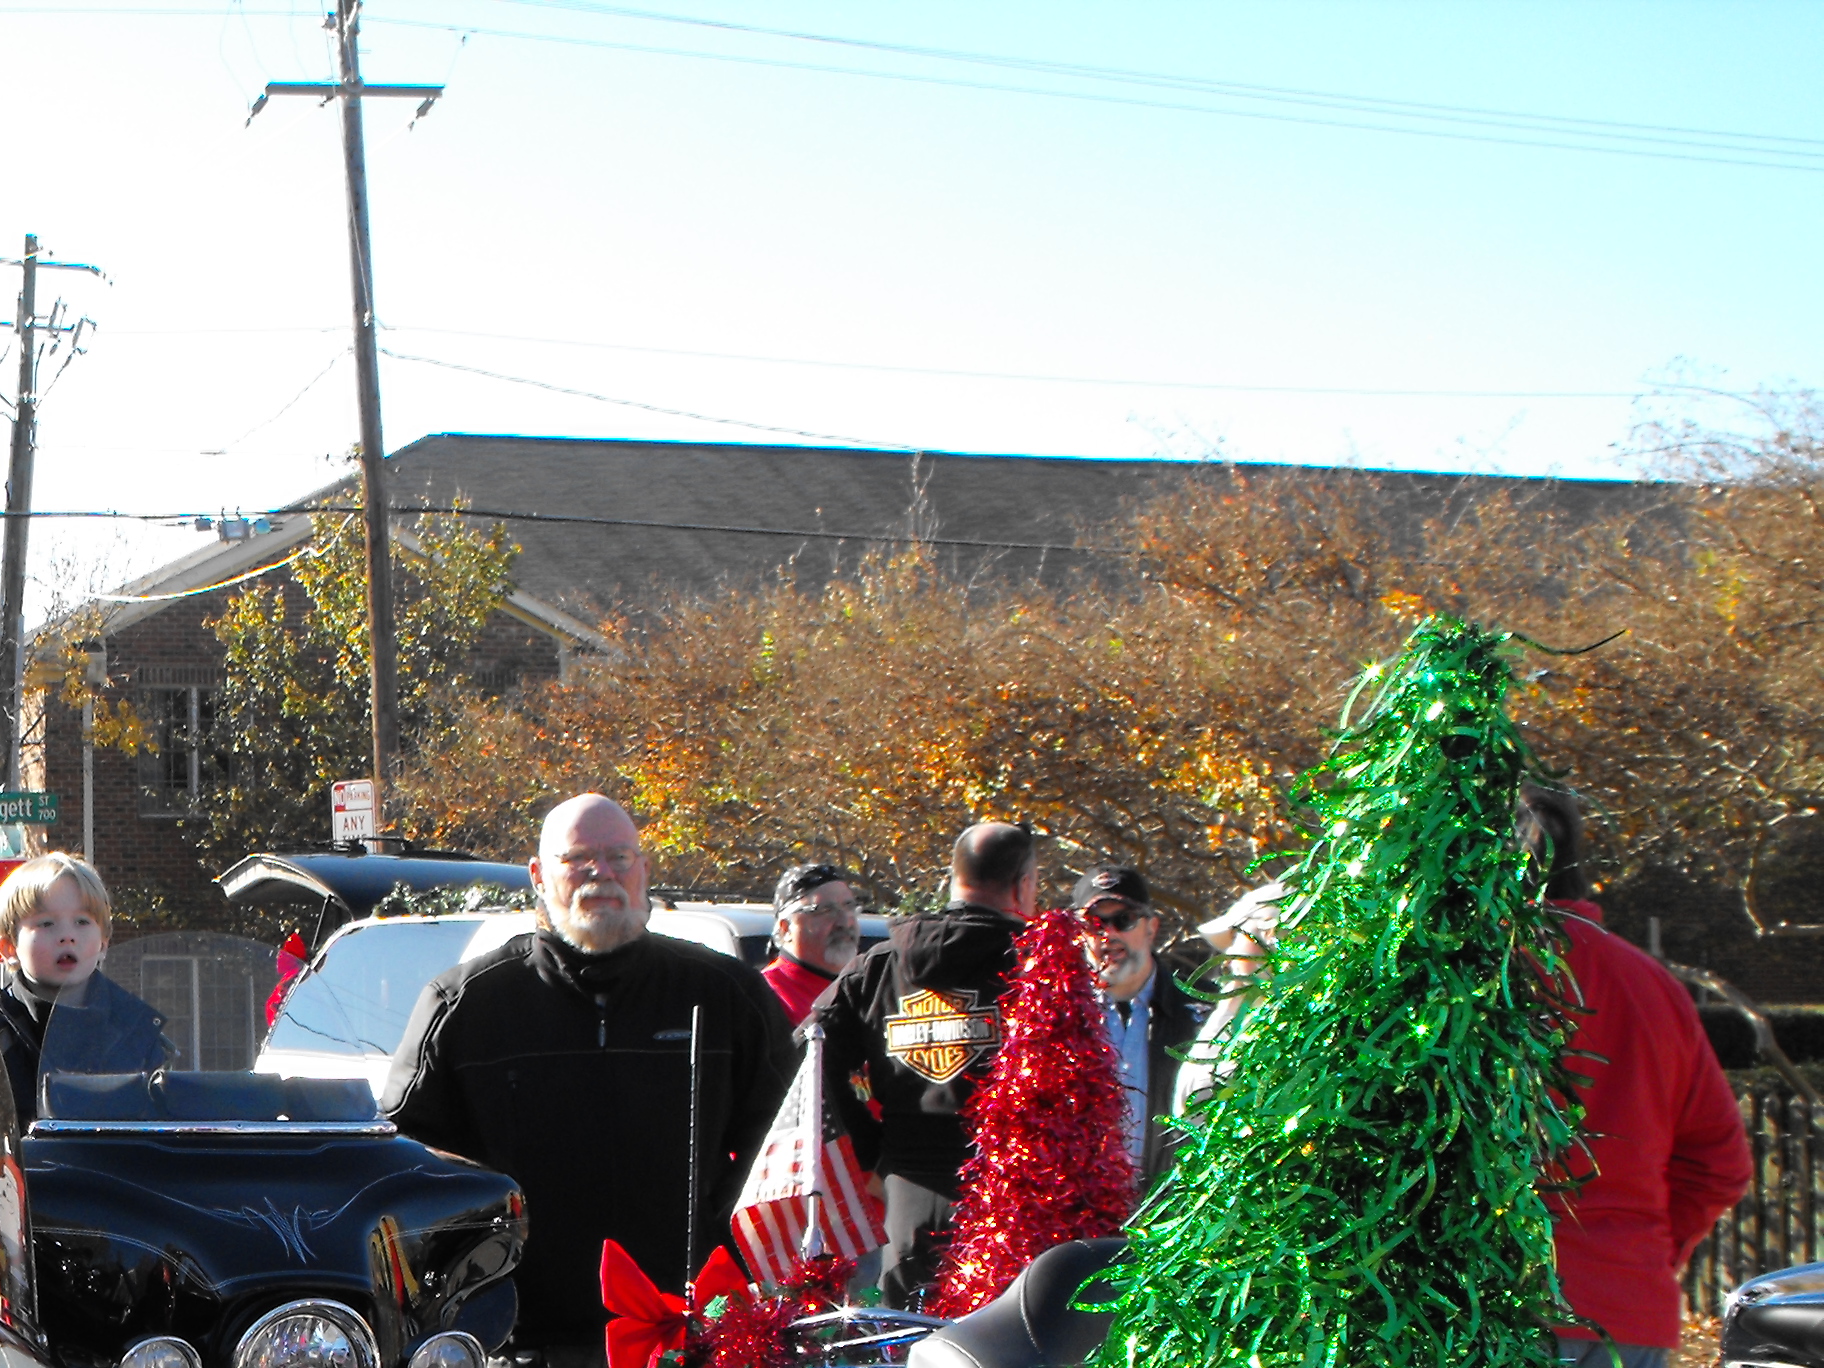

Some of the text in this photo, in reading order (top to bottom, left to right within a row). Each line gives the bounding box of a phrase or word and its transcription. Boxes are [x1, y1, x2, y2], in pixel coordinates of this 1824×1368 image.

[39, 796, 49, 806] ST
[39, 809, 56, 820] 700
[344, 816, 364, 831] ANY
[911, 995, 965, 1018] MOTOR
[890, 1018, 991, 1047] HARLEY-DAVIDSON
[914, 1046, 964, 1073] CYCLES
